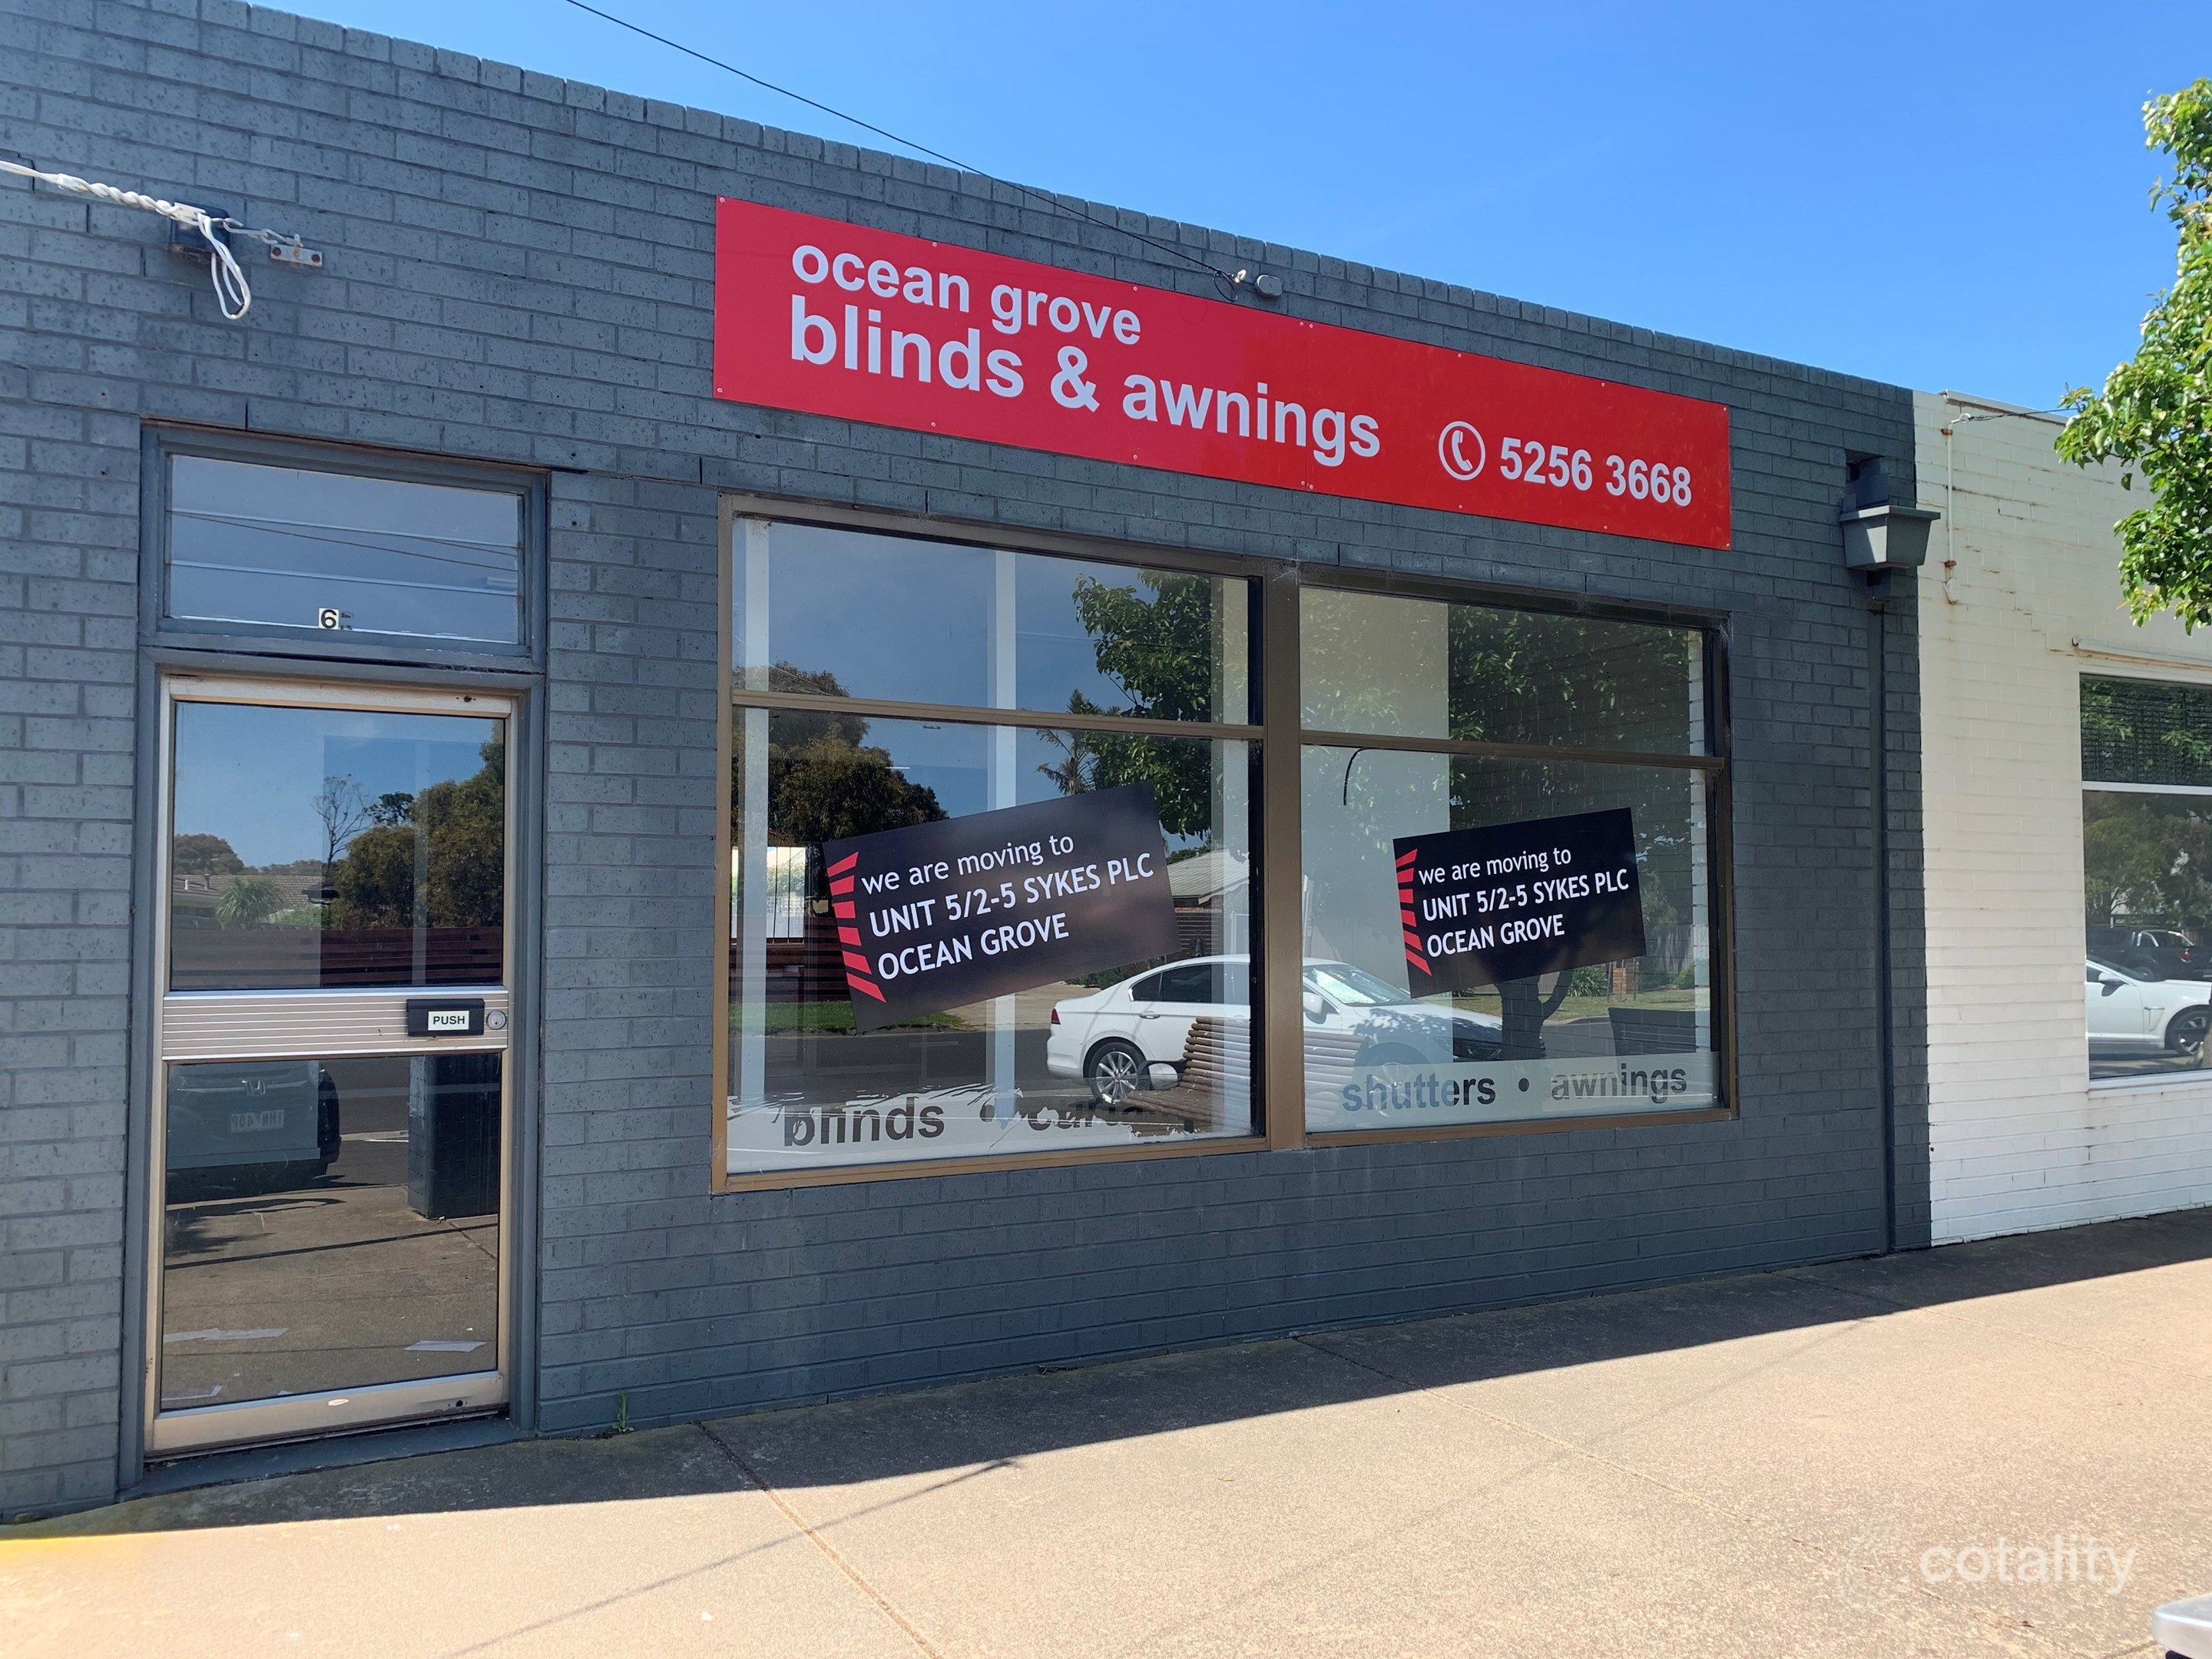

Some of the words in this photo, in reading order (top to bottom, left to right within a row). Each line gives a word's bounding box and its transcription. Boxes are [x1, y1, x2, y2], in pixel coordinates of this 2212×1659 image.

[792, 244, 969, 313] ocean
[991, 284, 1141, 345] grove
[791, 293, 1024, 398] blinds
[1050, 346, 1101, 412] &
[1122, 374, 1380, 467] awnings
[1500, 436, 1593, 491] 5256
[1605, 455, 1692, 507] 3668
[321, 609, 336, 629] 6
[861, 872, 900, 895] we
[909, 862, 949, 886] are
[957, 841, 1044, 876] moving
[1049, 835, 1074, 856] to
[1419, 867, 1445, 886] we
[1452, 862, 1481, 881] are
[1486, 849, 1549, 876] moving
[1553, 847, 1571, 866] to
[869, 899, 936, 937] UNIT
[945, 882, 1016, 921] 5/2-5
[1023, 864, 1101, 903] SYKES
[1107, 853, 1154, 886] PLC
[1422, 892, 1470, 921] UNIT
[1476, 883, 1528, 913] 5/2-5
[1533, 874, 1590, 904] SYKES
[1594, 869, 1629, 894] PLC
[878, 935, 973, 980] OCEAN
[980, 912, 1069, 955] GROVE
[1427, 925, 1495, 958] OCEAN
[1500, 913, 1565, 945] GROVE
[433, 1015, 465, 1025] PUSH
[1342, 1072, 1497, 1111] shutters
[1551, 1062, 1687, 1104] awnings
